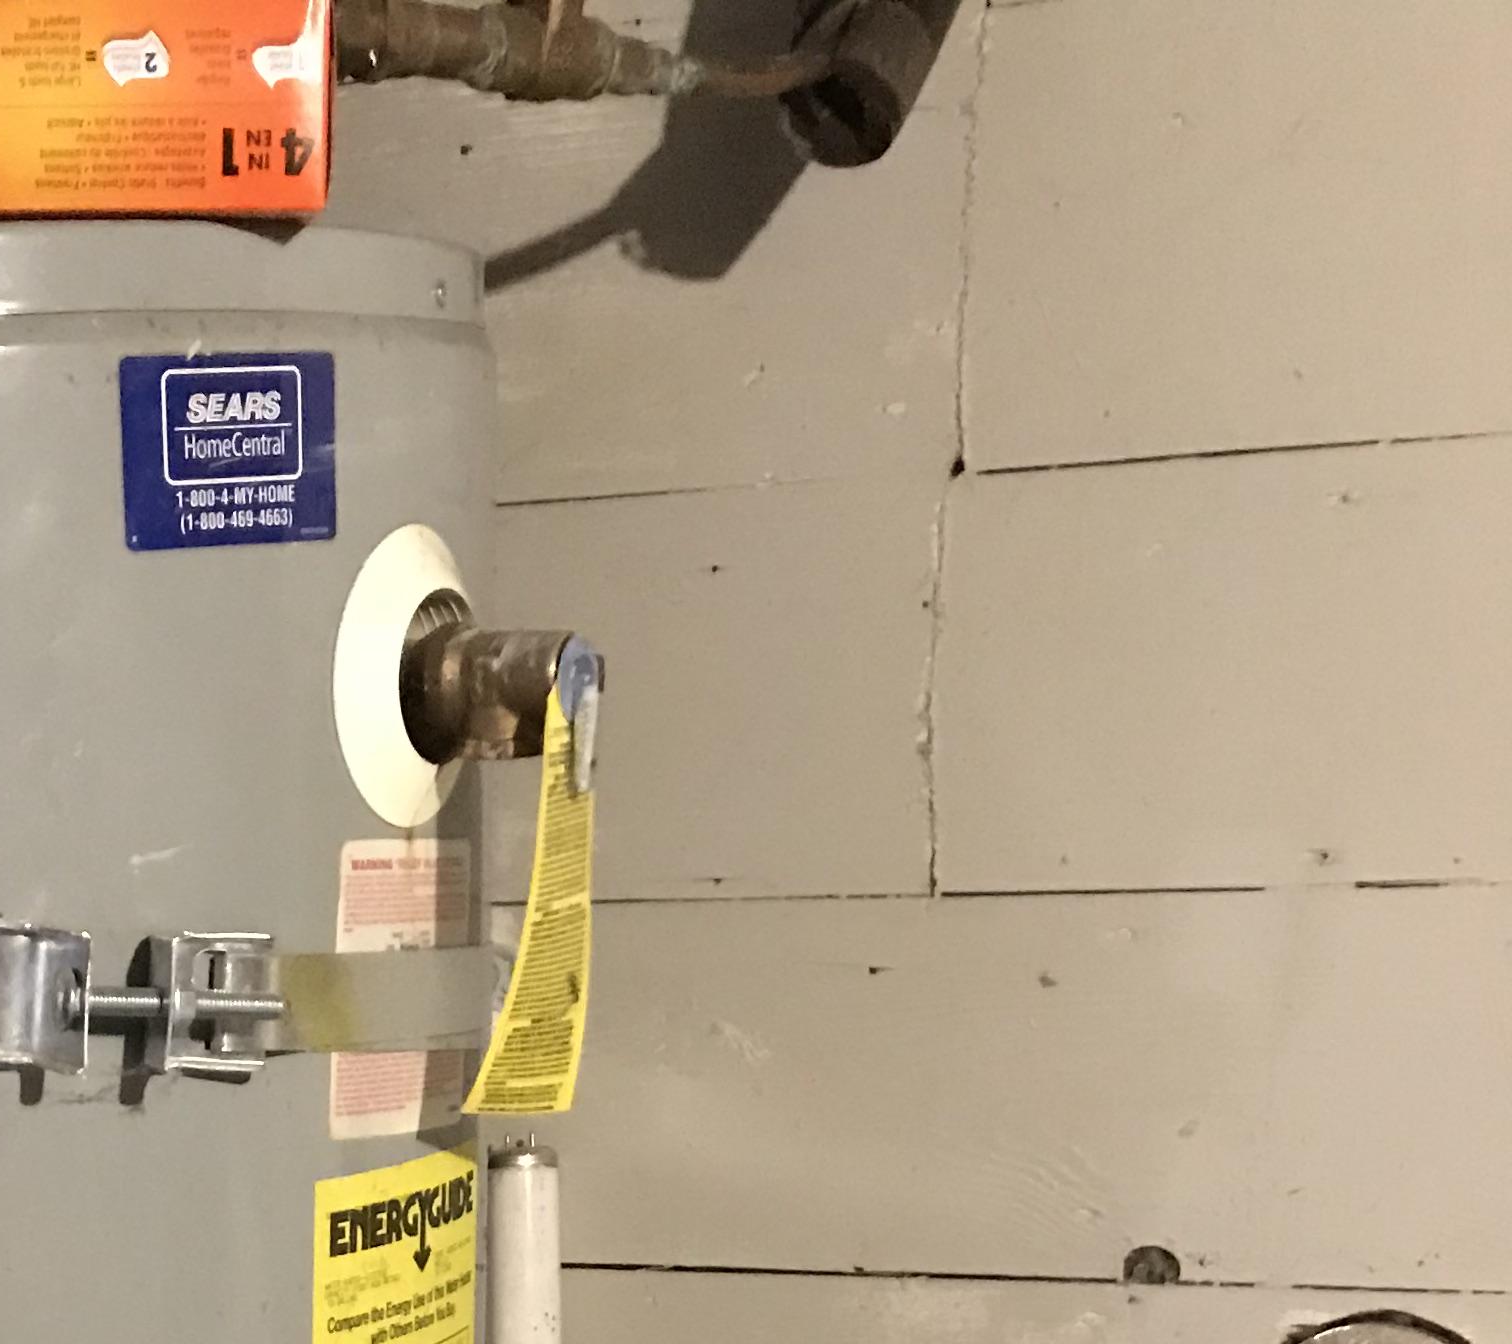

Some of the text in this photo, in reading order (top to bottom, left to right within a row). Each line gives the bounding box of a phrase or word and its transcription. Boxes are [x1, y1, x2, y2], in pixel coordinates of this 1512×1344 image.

[144, 53, 157, 72] 2
[246, 129, 272, 146] EN
[221, 128, 314, 177] 4 IN 1
[187, 390, 281, 423] SEARS
[184, 430, 285, 459] HomeCentral
[175, 485, 296, 508] 1-800-4-MY-HOME
[180, 508, 293, 534] (1-800-469-4663)
